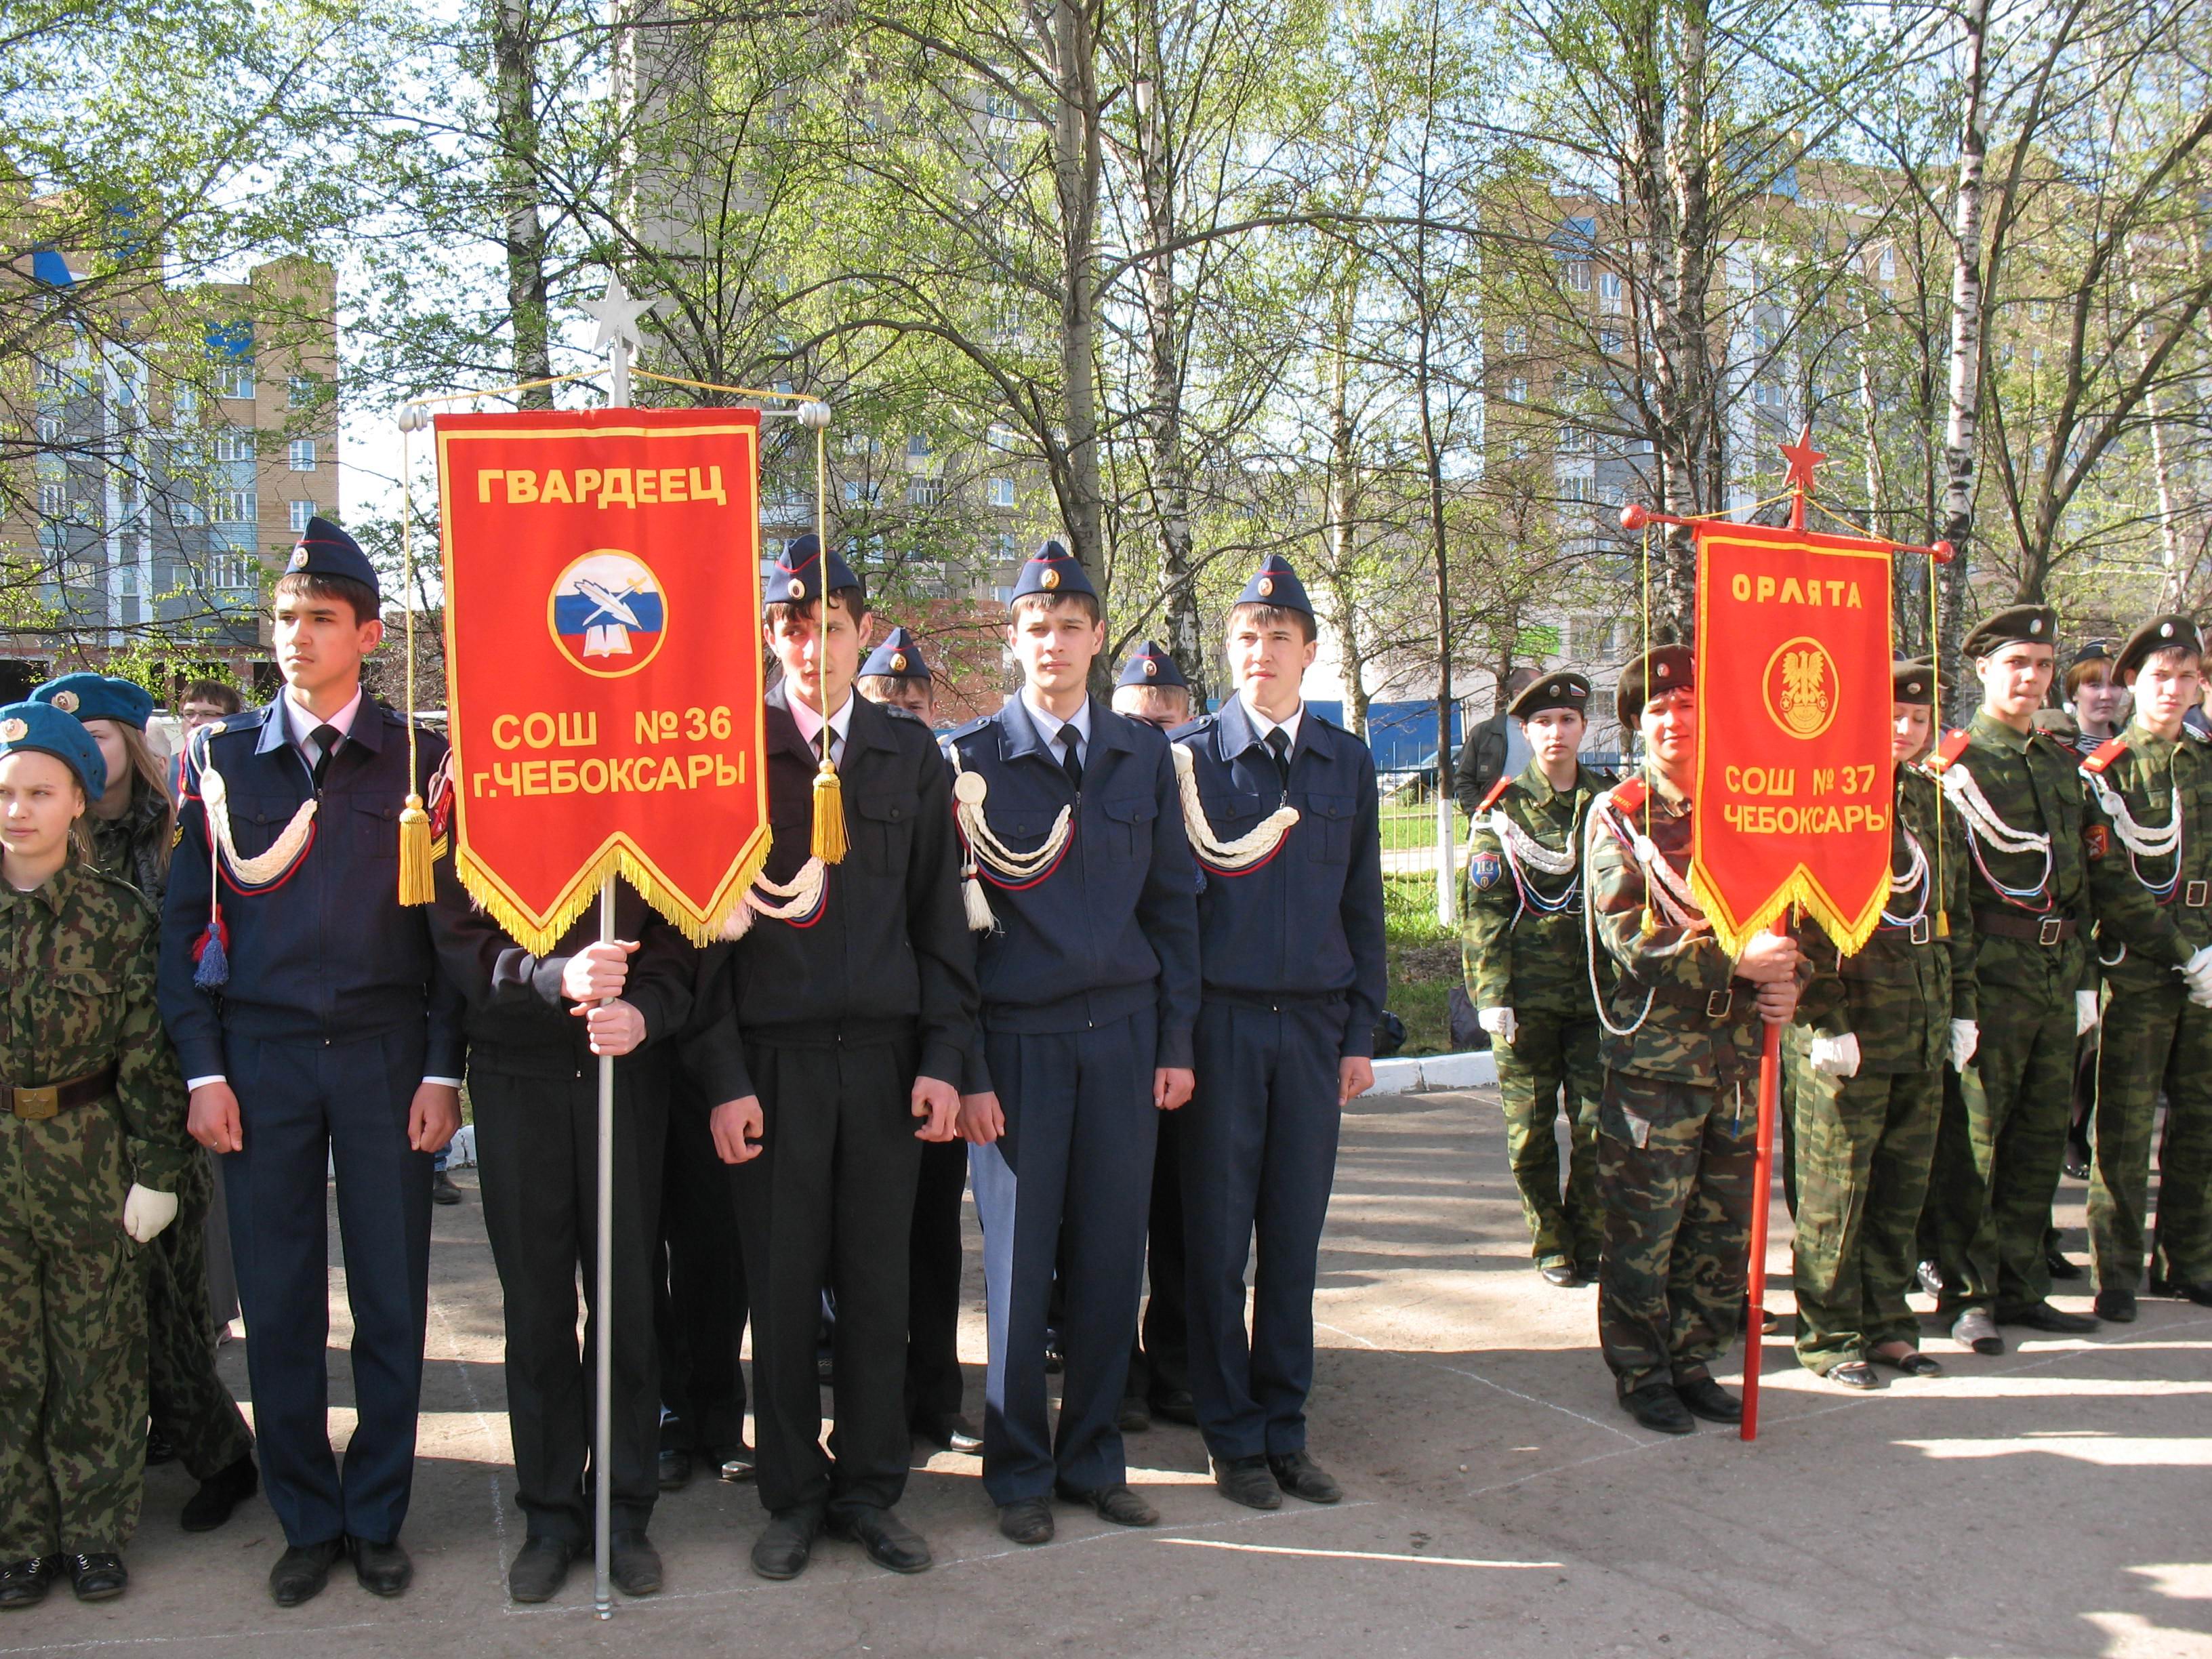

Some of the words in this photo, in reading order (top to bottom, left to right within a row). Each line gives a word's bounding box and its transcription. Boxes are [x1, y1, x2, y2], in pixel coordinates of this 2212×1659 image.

[477, 465, 727, 510] ГВАРДЕЕЦ
[1732, 573, 1863, 609] ОРЛЯТА
[491, 710, 597, 750] СОШ
[1725, 764, 1795, 797] СОШ
[1723, 802, 1890, 835] ЧЕБОКСАРЫ
